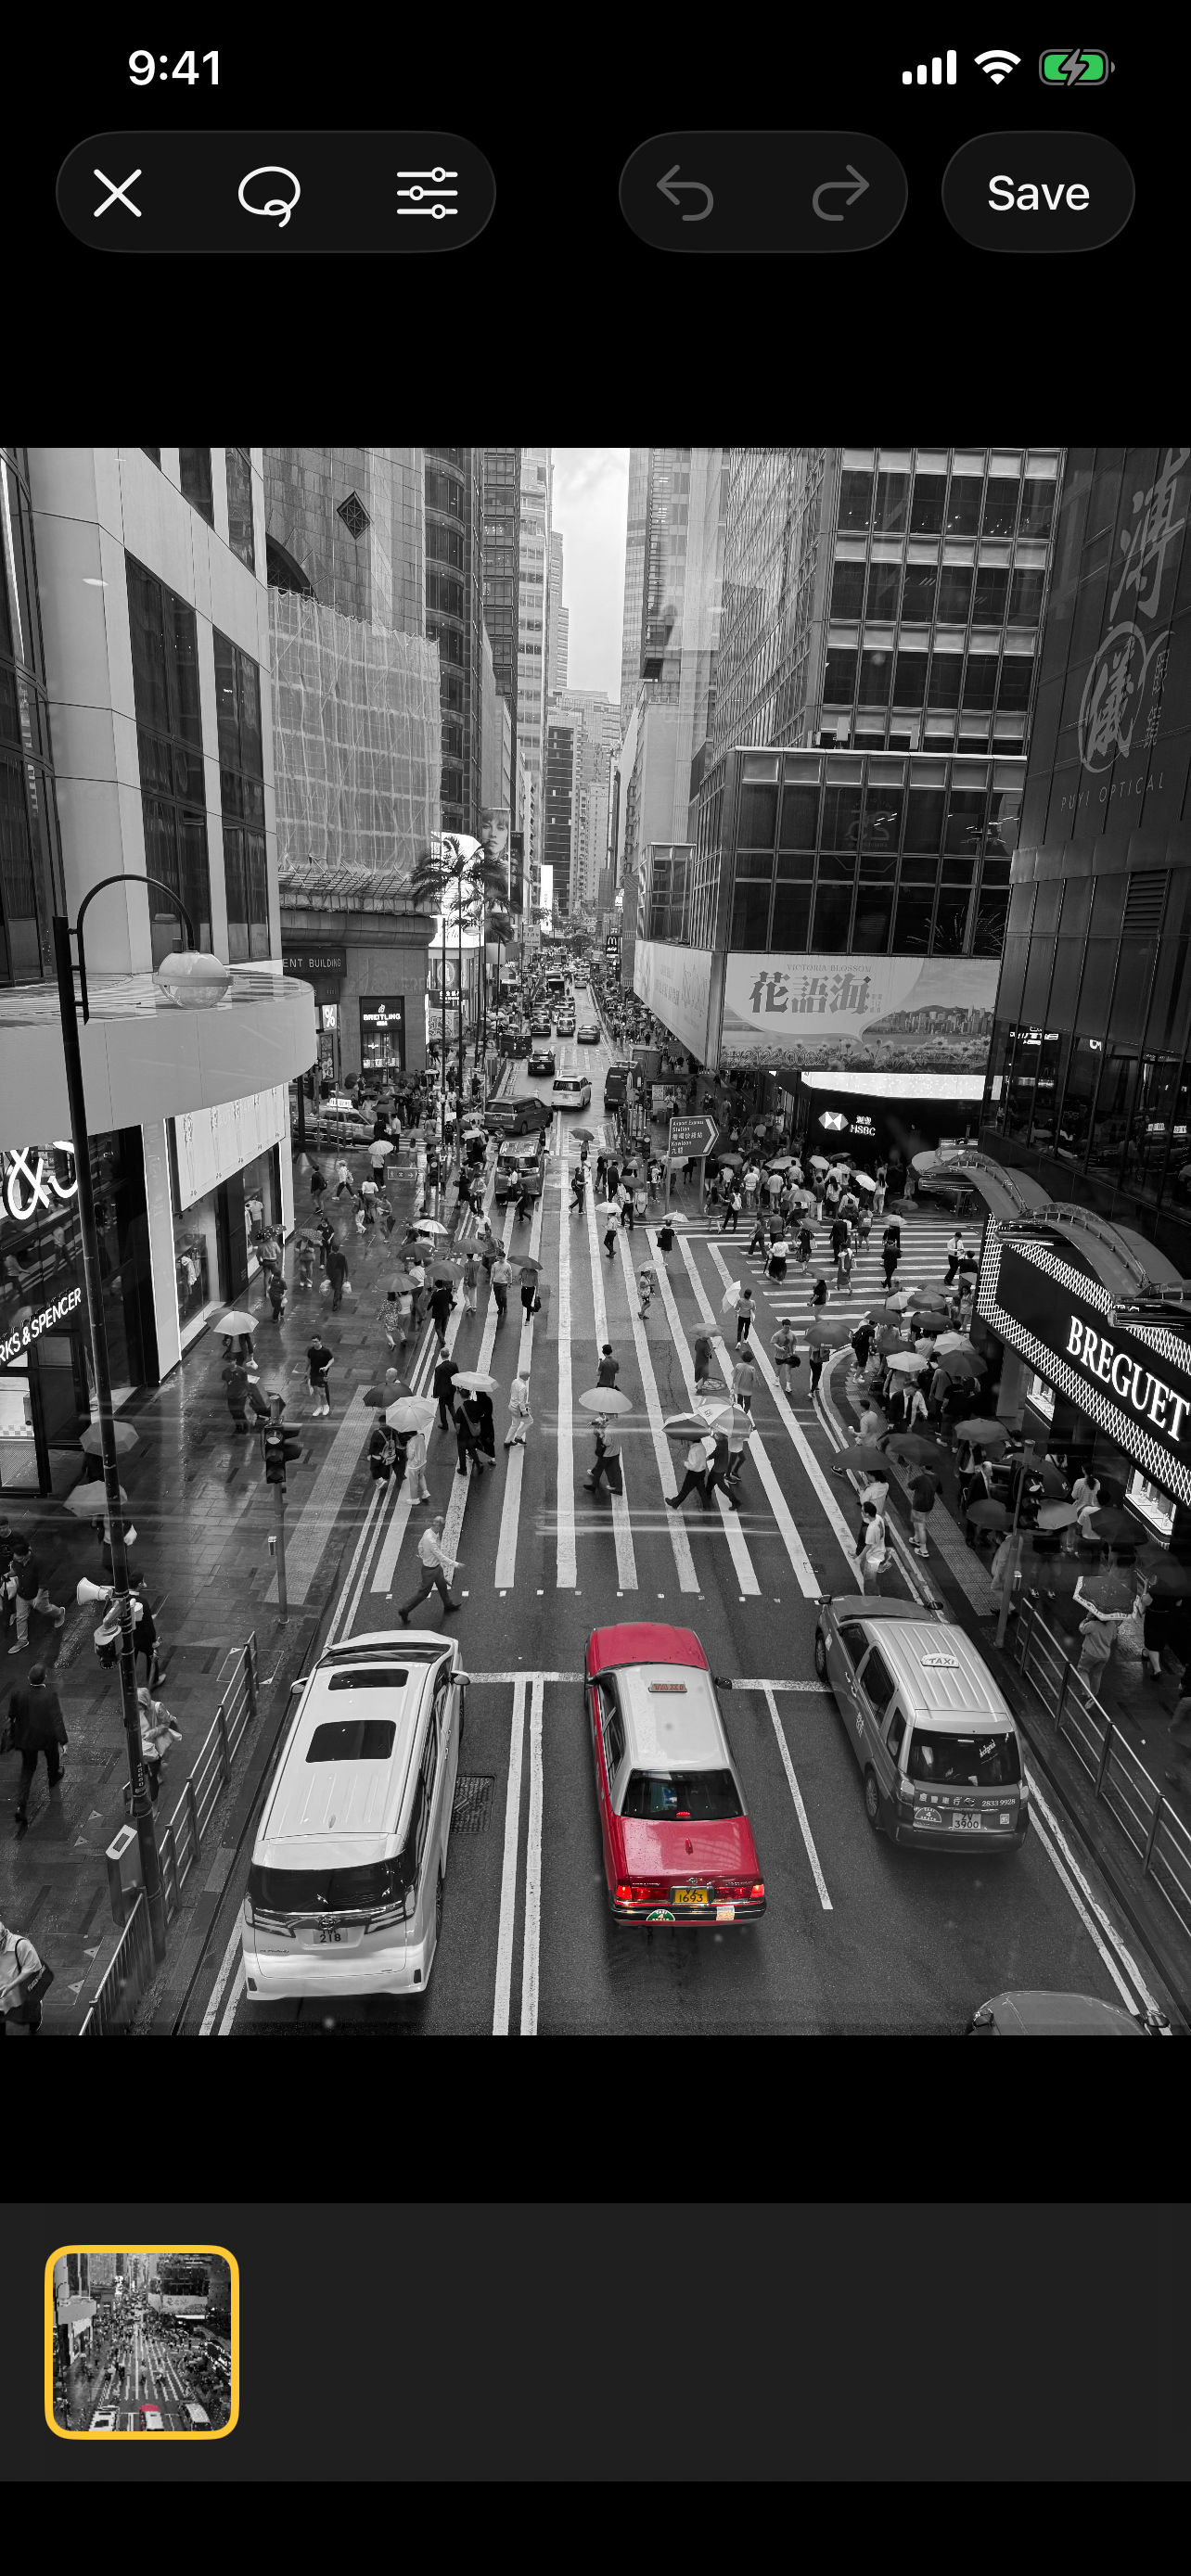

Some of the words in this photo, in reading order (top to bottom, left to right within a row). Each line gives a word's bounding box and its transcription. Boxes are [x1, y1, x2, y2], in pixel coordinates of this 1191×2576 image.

[1060, 790, 1090, 811] PUYI
[1098, 772, 1164, 804] OPTICAL
[309, 958, 341, 968] BUILDING
[788, 963, 827, 972] VICTORIA
[830, 964, 872, 973] BLOSSOM
[749, 971, 871, 1014] 花語海
[363, 1013, 402, 1021] BREITLING
[850, 1124, 877, 1137] HSBC
[0, 1333, 21, 1362] RKS
[21, 1326, 32, 1346] &
[31, 1287, 82, 1338] SPENCER
[1066, 1315, 1191, 1442] BREGUET
[928, 1657, 954, 1665] TAXI
[653, 1683, 685, 1691] TAXI
[954, 1820, 980, 1829] 3900
[679, 1894, 703, 1903] 1693
[320, 1933, 341, 1943] 218
